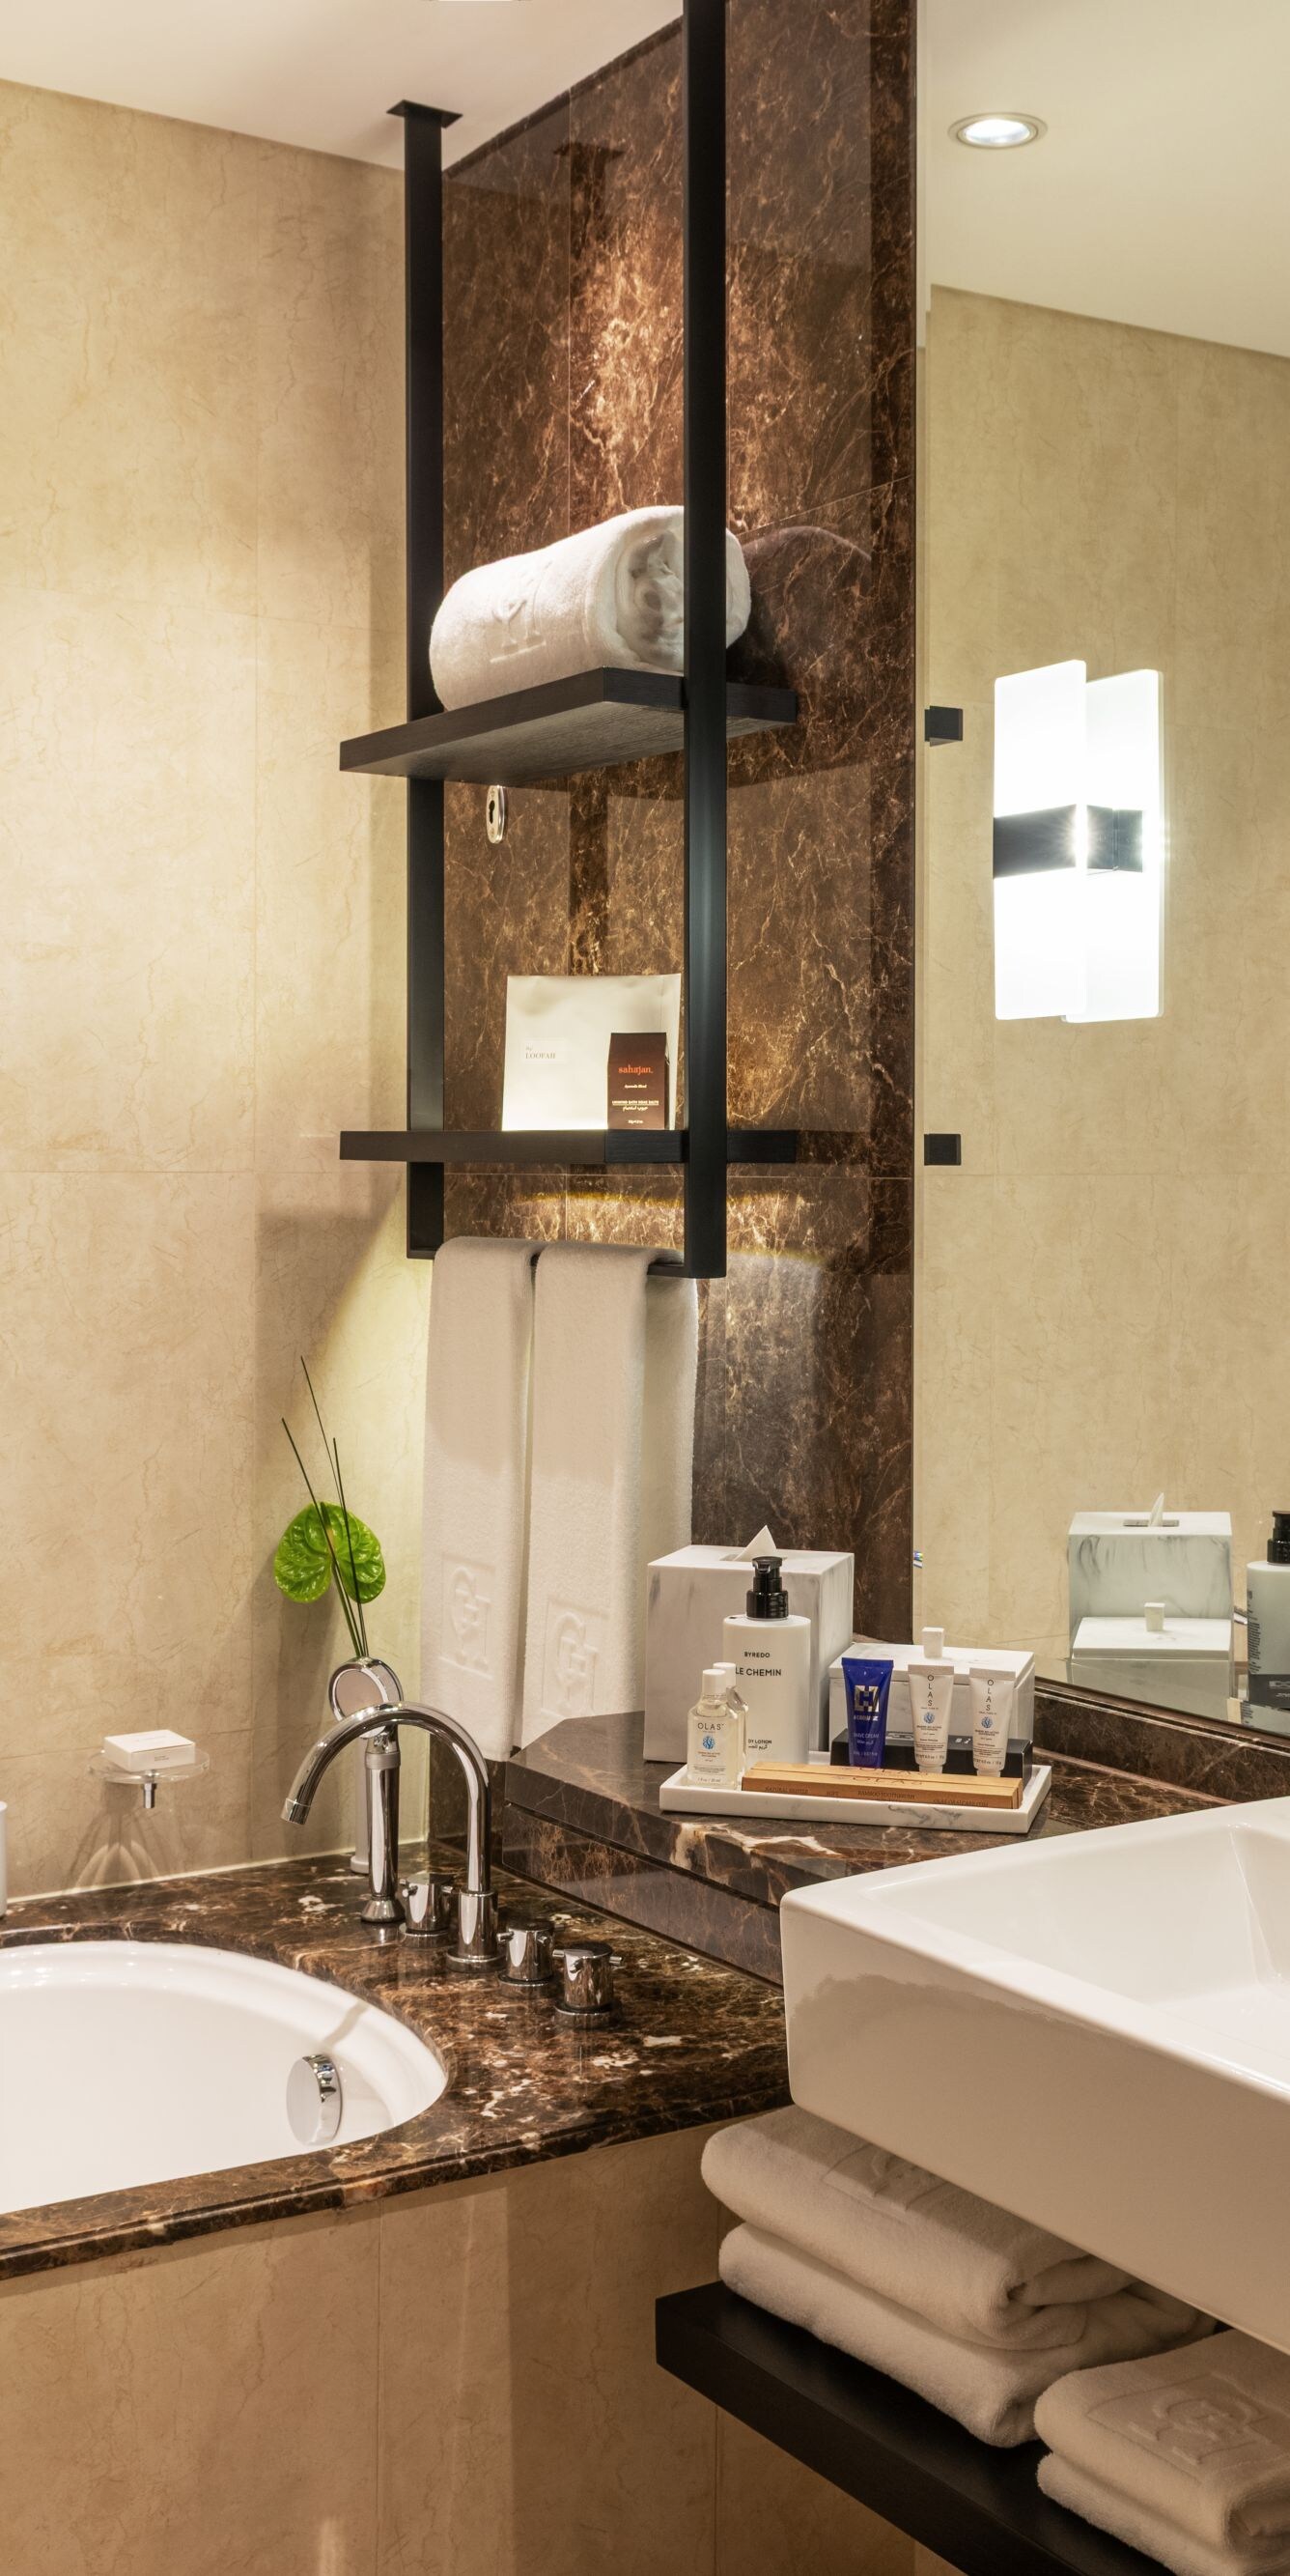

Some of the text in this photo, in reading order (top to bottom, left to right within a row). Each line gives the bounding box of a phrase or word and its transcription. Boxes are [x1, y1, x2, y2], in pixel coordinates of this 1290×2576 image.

[735, 1667, 782, 1677] LE CHEMIN
[986, 1679, 995, 1712] OLAS
[697, 1722, 722, 1731] OLAS
